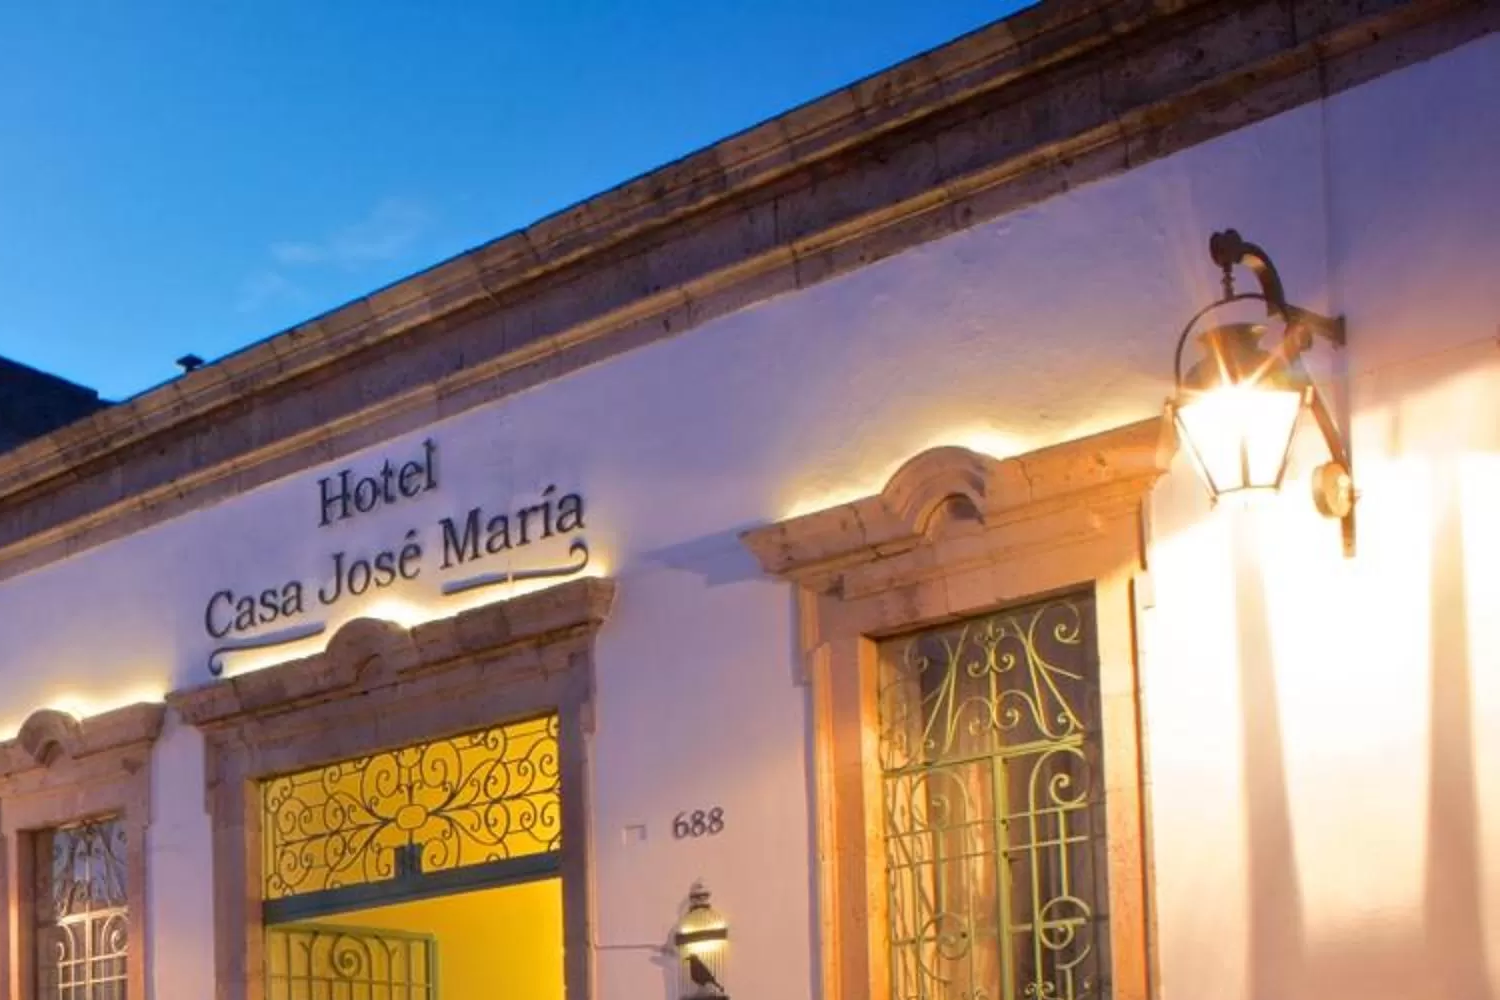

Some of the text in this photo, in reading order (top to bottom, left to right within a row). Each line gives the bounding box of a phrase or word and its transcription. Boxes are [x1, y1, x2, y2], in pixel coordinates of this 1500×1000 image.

[318, 438, 438, 528] Hotel
[205, 484, 585, 640] Casa José María
[673, 806, 725, 840] 688
